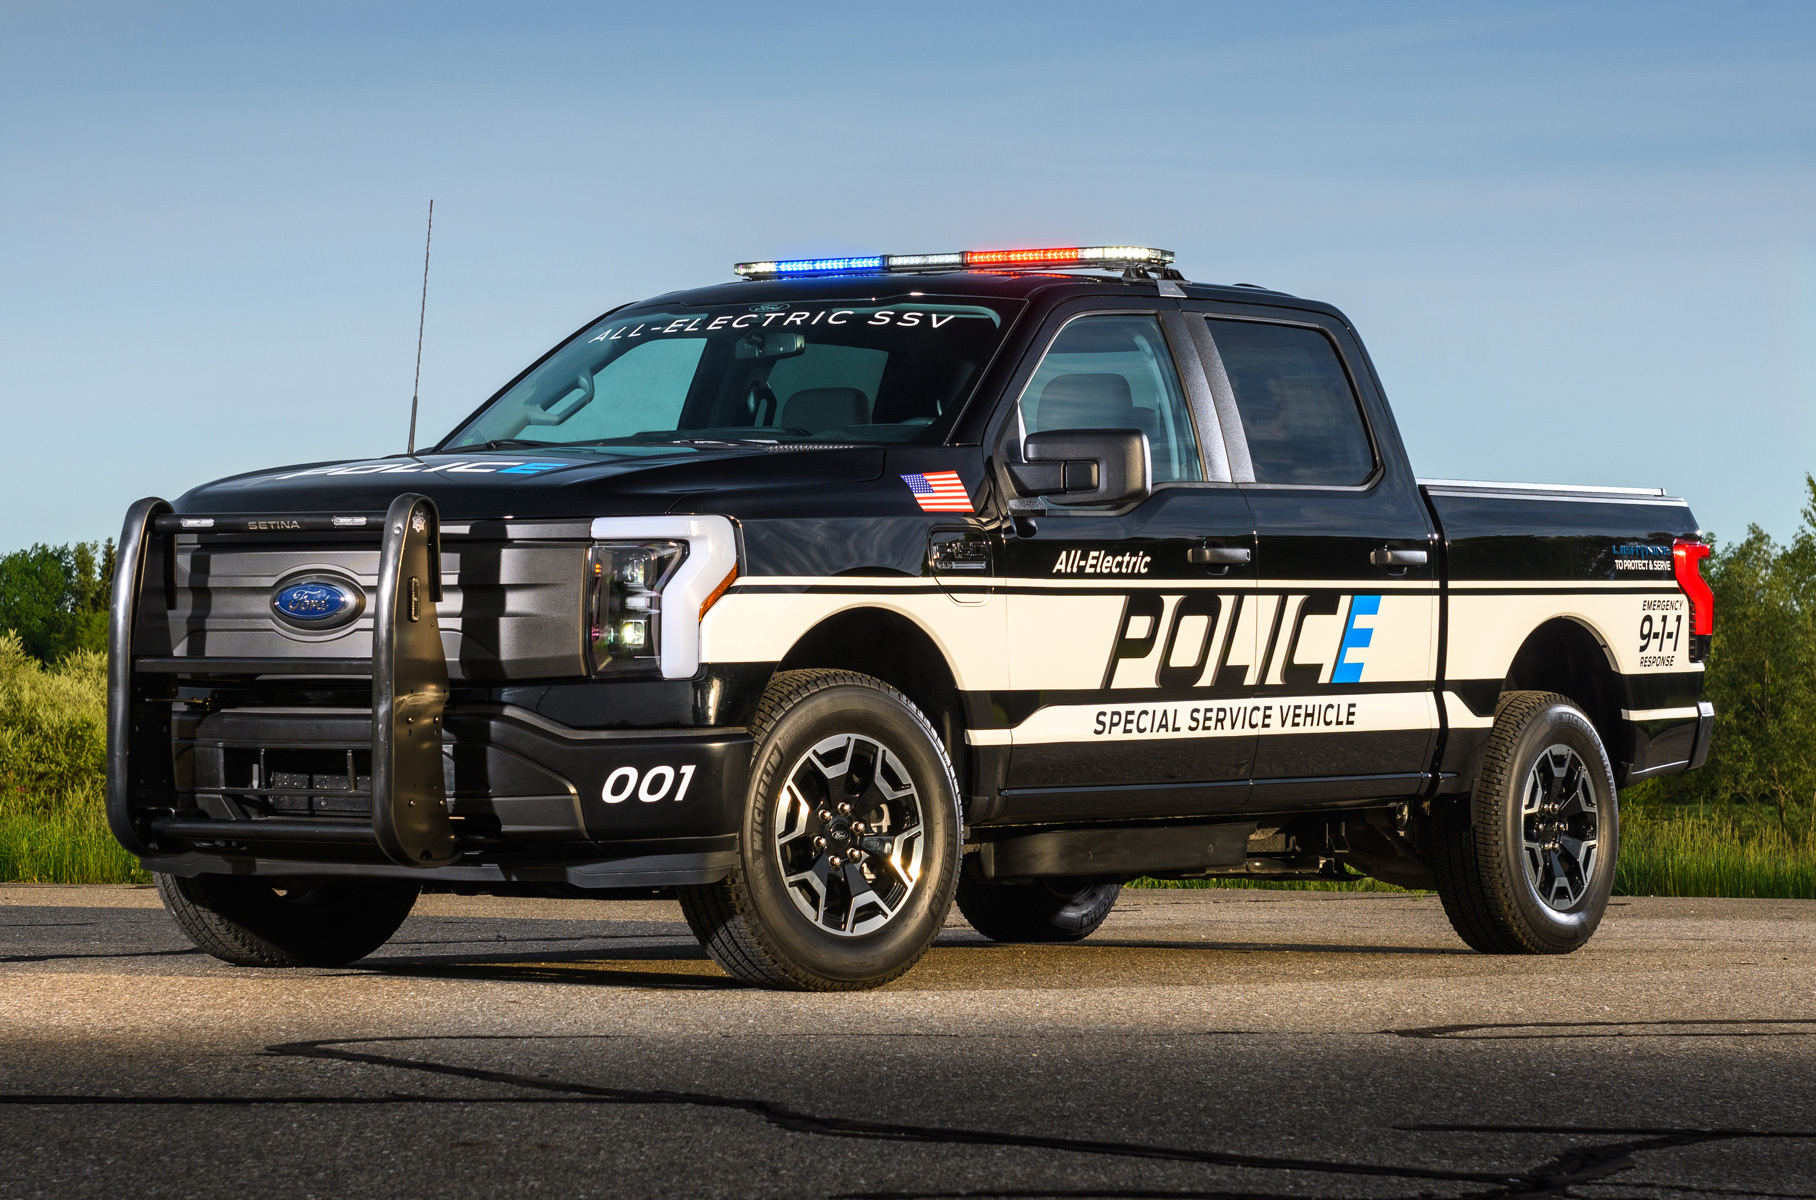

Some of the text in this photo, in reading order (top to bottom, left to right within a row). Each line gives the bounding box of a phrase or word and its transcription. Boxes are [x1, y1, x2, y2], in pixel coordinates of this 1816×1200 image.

[588, 311, 955, 344] ALL-ELECTRIC SSV
[275, 462, 570, 480] POLICE
[247, 520, 301, 530] SETINA
[1052, 550, 1152, 574] All-Electric
[1615, 560, 1672, 571] TO PROTECT & SERVE
[288, 589, 330, 612] Ford
[1643, 600, 1684, 611] EMERGENCY
[1100, 594, 1382, 689] POLICE
[1639, 614, 1682, 652] 9-1-1
[1640, 656, 1675, 667] RESPONSE
[1093, 703, 1357, 735] SPECIAL SERVICE VEHICLE
[601, 765, 697, 804] 001
[753, 747, 782, 851] MICHELIN
